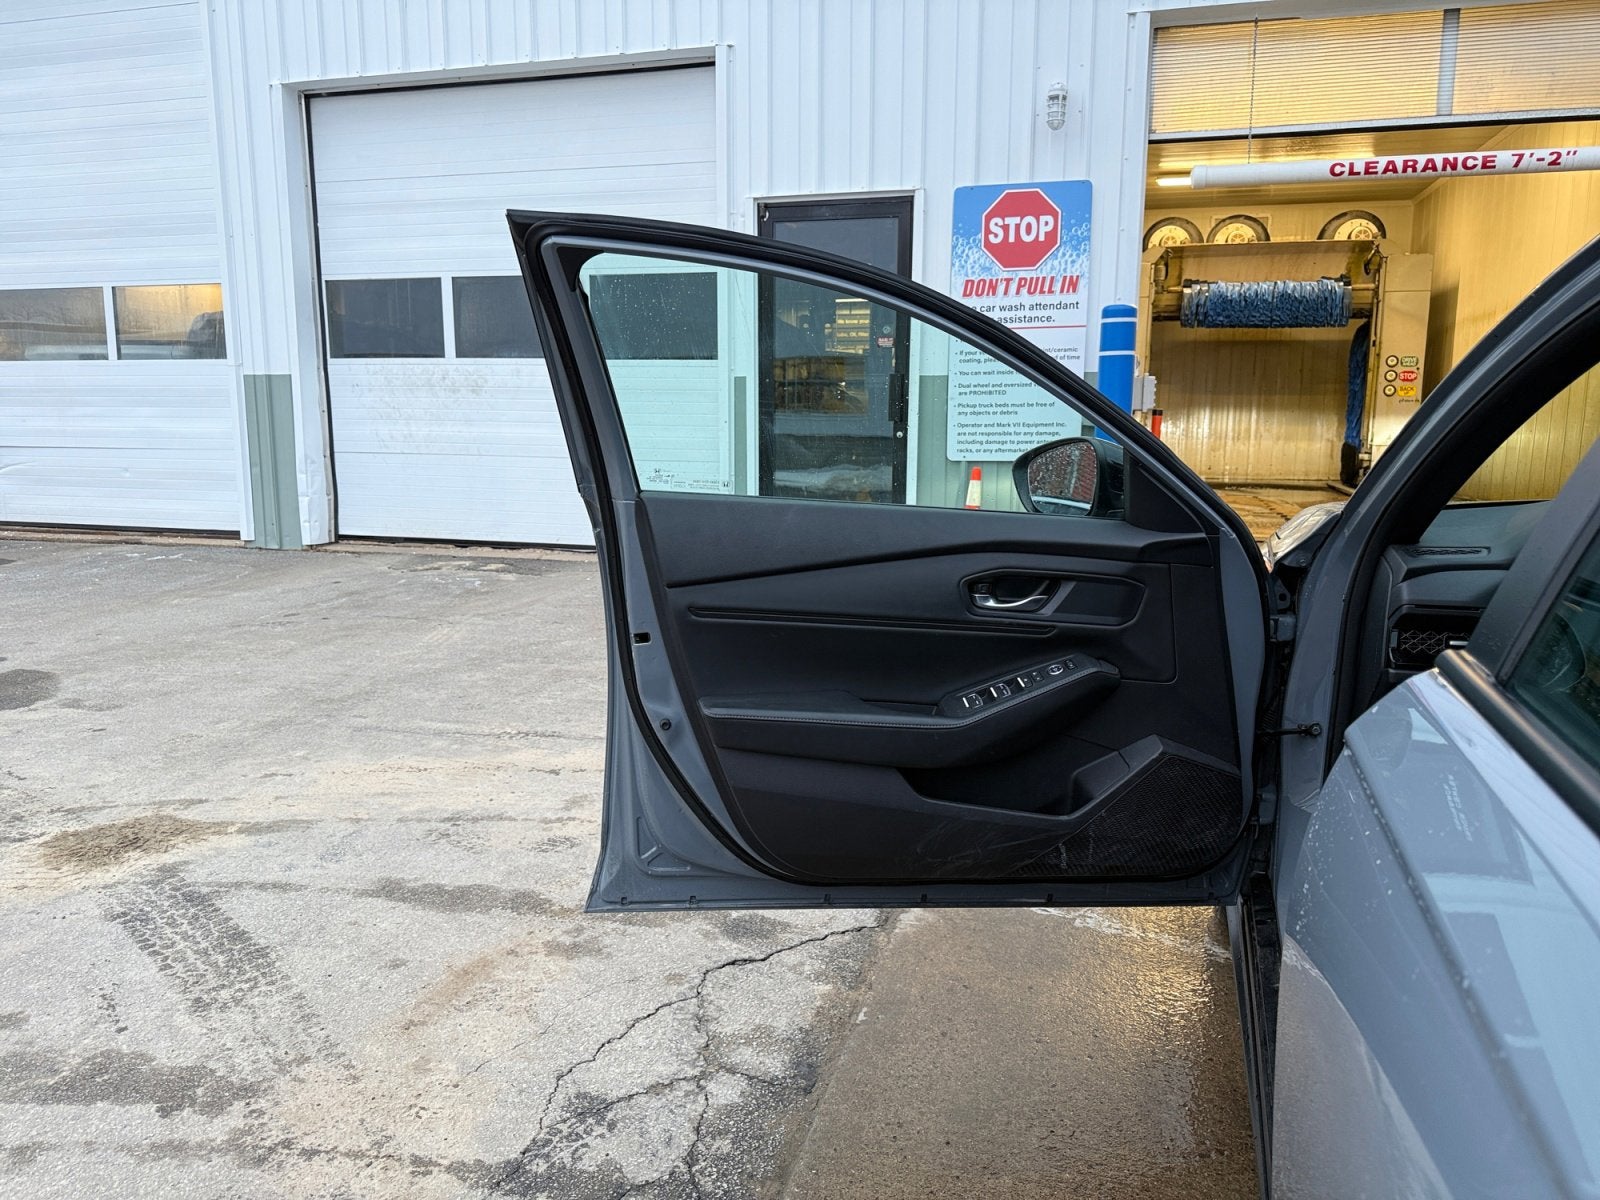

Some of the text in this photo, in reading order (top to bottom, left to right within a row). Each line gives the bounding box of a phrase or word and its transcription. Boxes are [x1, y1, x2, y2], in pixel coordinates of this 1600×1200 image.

[1329, 150, 1578, 177] CLEARANCE 7'-2"
[988, 215, 1054, 244] STOP
[962, 274, 1080, 298] DON'T PULL IN
[998, 302, 1026, 312] wash
[1028, 301, 1080, 311] attendant
[997, 314, 1056, 324] assistance.
